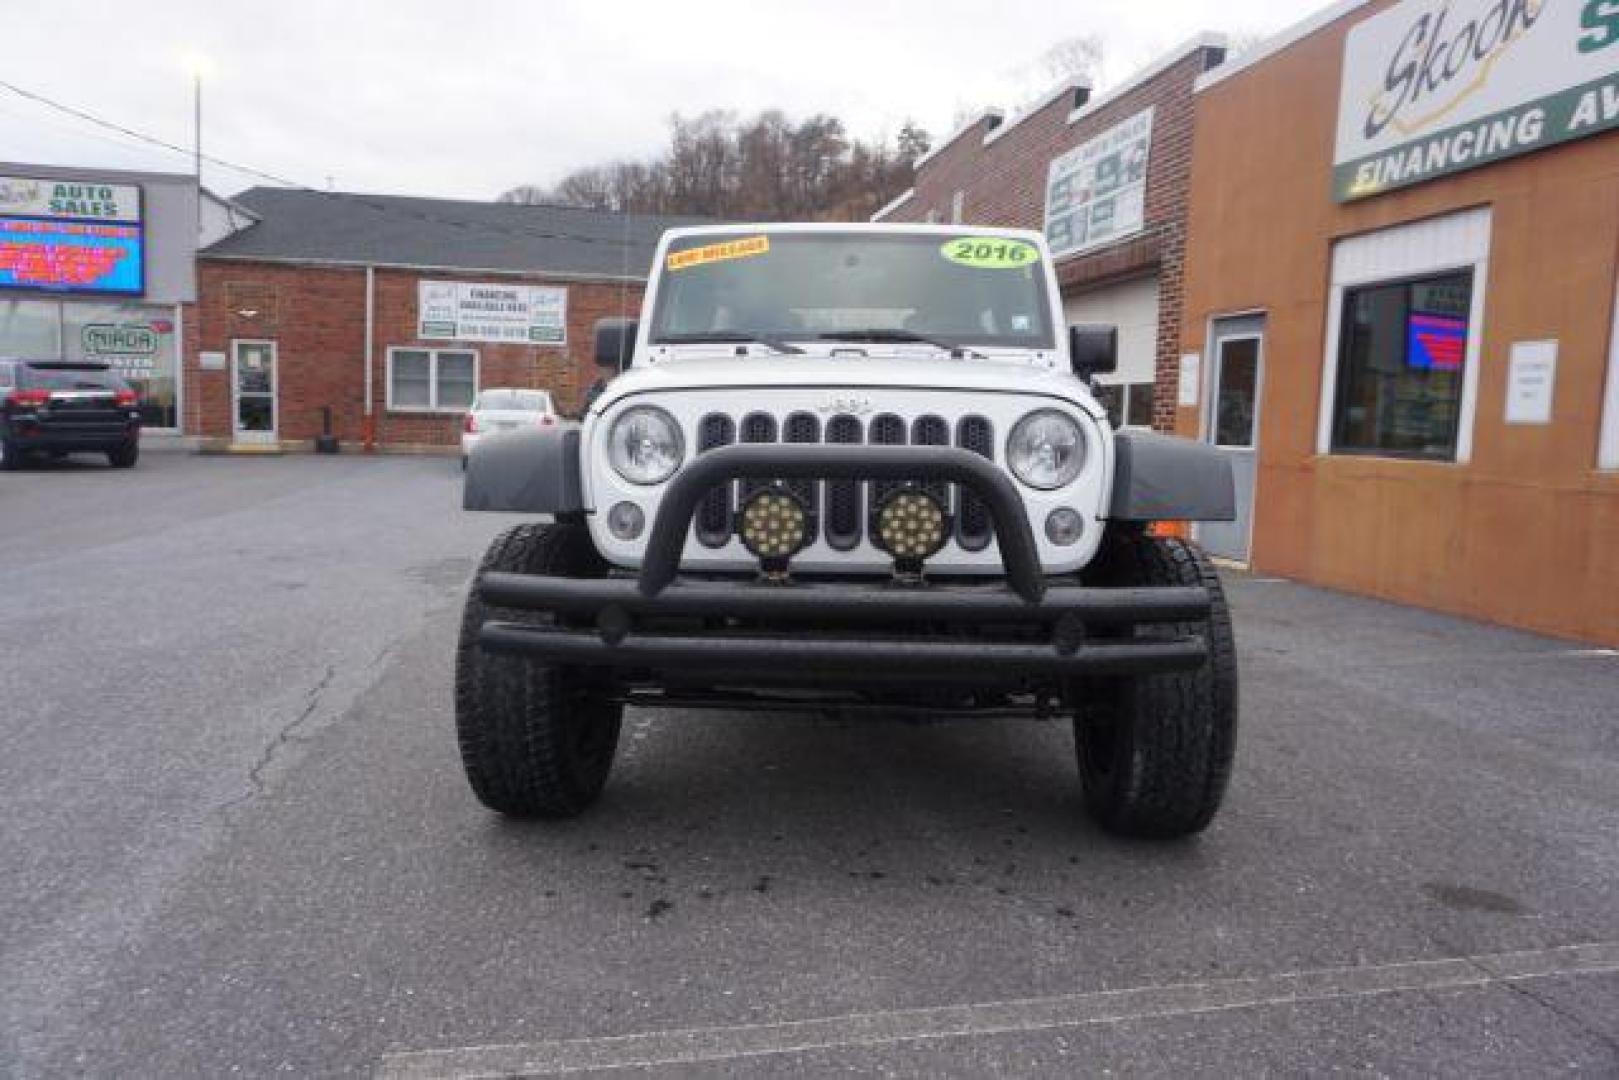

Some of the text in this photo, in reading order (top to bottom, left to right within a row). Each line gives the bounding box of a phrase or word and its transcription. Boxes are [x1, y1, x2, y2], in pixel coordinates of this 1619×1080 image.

[1353, 108, 1545, 190] FINANCING
[53, 184, 113, 199] AUTO
[50, 199, 117, 216] SALES
[702, 239, 765, 259] MILEAGE
[954, 243, 1026, 261] 2016
